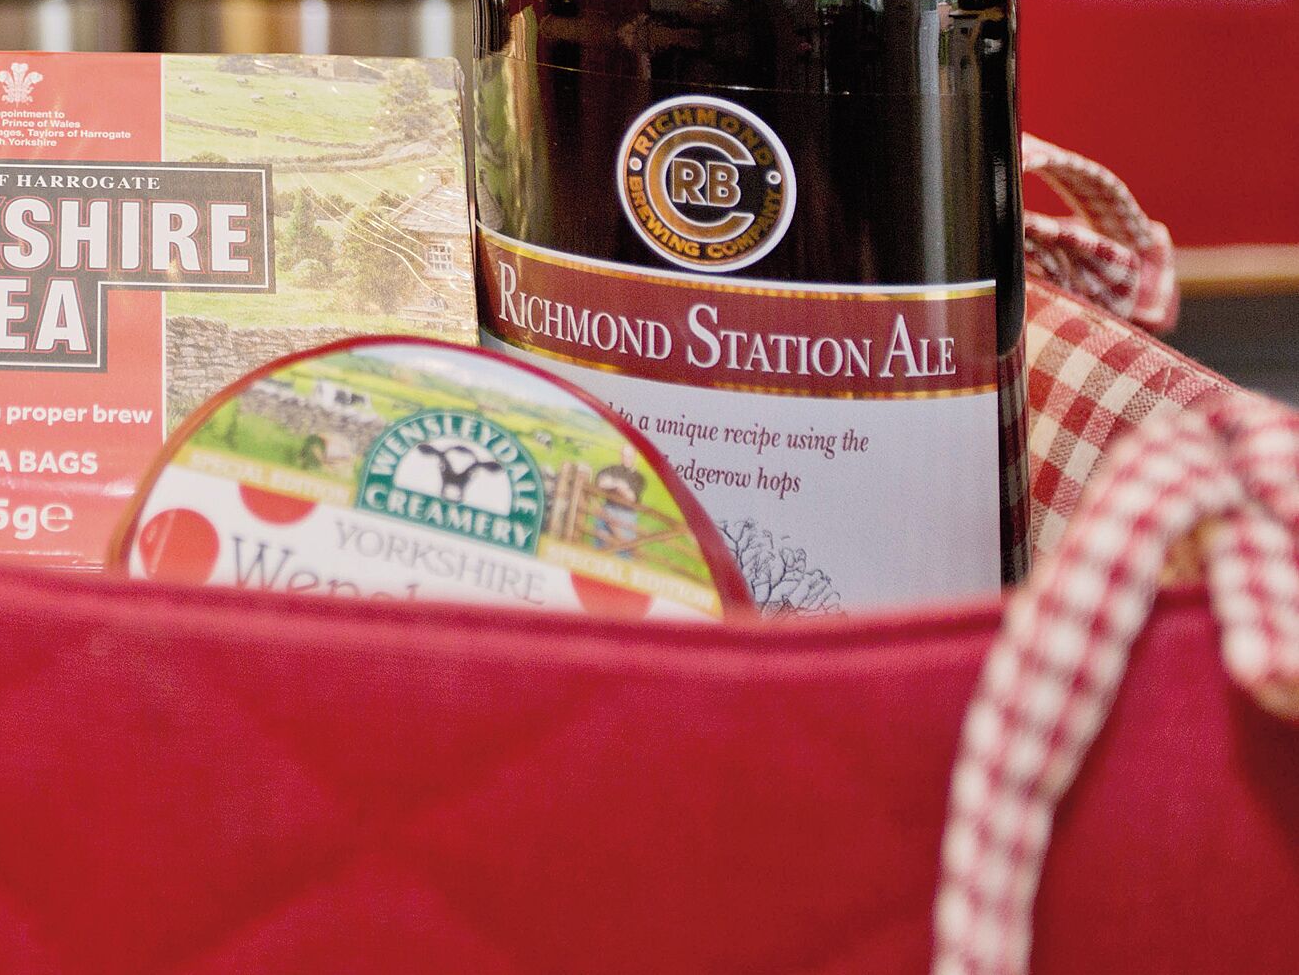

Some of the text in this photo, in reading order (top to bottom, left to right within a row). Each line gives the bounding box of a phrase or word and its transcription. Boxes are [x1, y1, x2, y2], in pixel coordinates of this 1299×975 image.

[2, 119, 35, 128] Prince
[37, 120, 48, 128] of
[49, 120, 81, 129] Wales
[54, 111, 65, 119] to
[9, 138, 57, 147] Yorkshire
[28, 128, 65, 139] Taylors
[67, 130, 78, 138] of
[80, 130, 132, 140] Harrogate
[633, 107, 774, 167] RICHMOND
[17, 174, 161, 191] HARROGATE
[627, 176, 783, 258] BREWING COMPANY
[6, 406, 88, 426] proper
[93, 404, 153, 424] brew
[639, 414, 649, 431] a
[655, 414, 719, 447] unique
[723, 423, 781, 455] recipe
[786, 427, 838, 460] using
[842, 428, 870, 453] the
[19, 451, 99, 475] BAGS
[370, 413, 538, 516] WENSLEYDALE
[664, 454, 802, 500] edgerow hops
[364, 482, 533, 547] CREAMERY
[335, 520, 546, 605] YORKSHIRE
